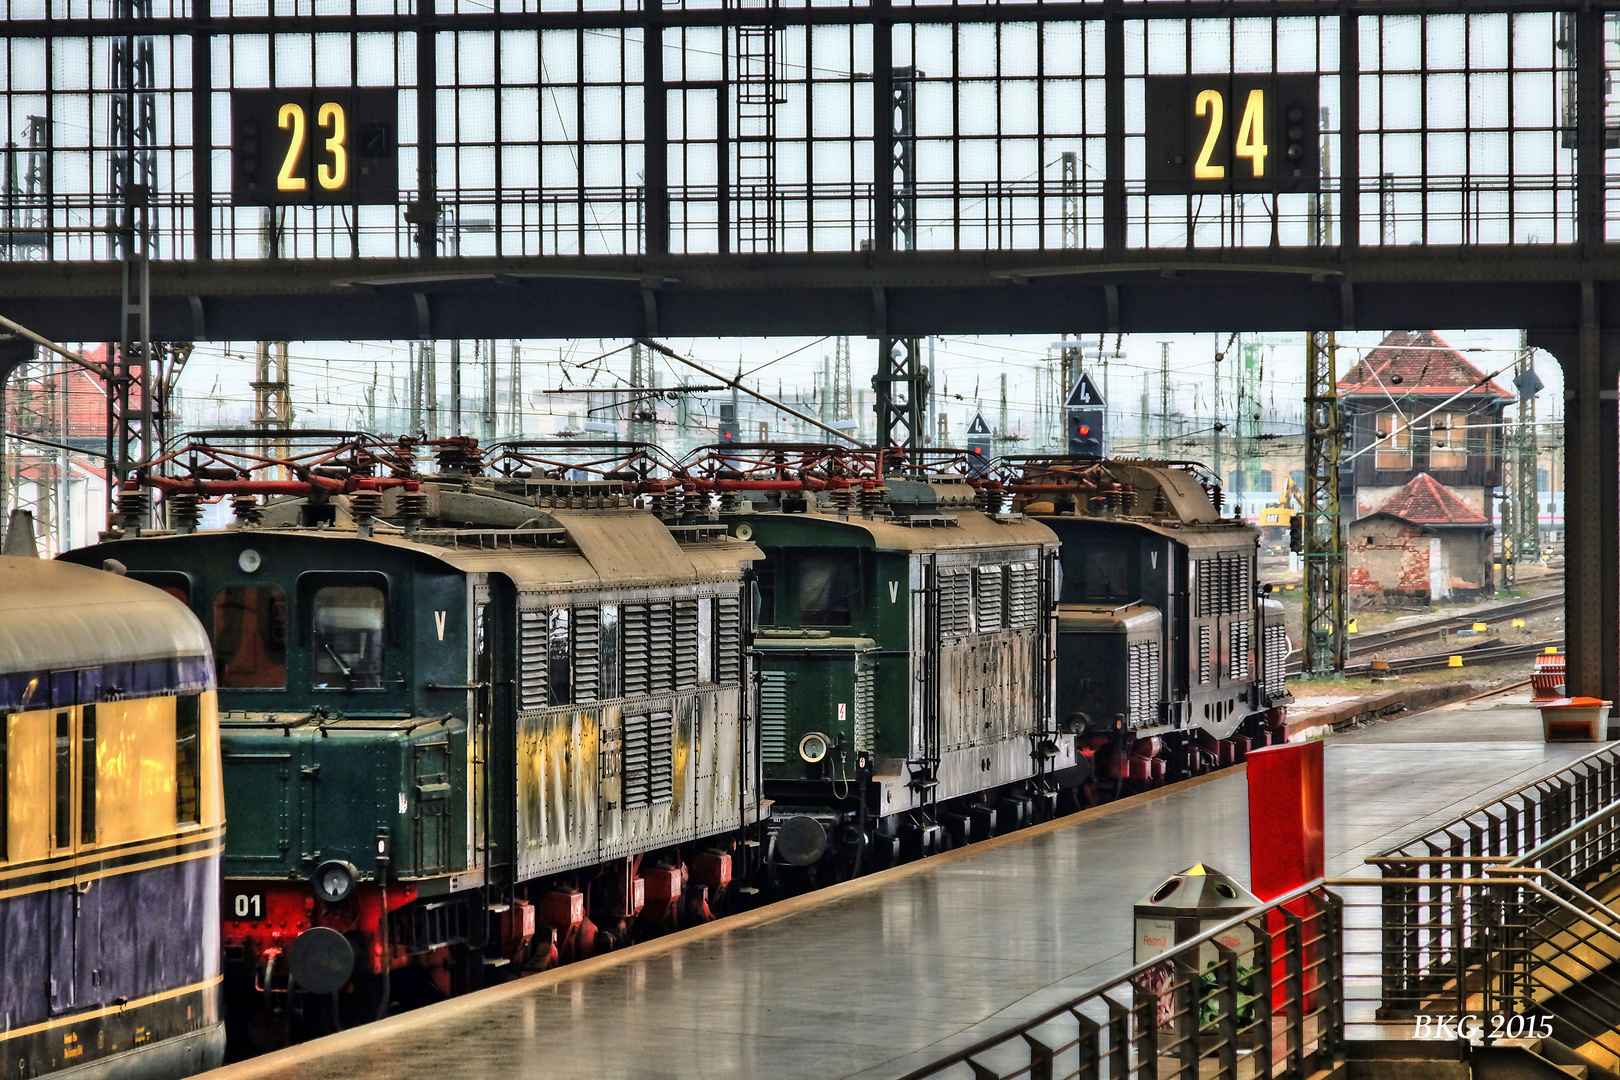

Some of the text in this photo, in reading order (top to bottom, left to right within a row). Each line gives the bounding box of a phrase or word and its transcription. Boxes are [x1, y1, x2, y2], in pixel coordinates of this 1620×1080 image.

[1194, 89, 1268, 179] 24
[277, 102, 348, 190] 23
[1080, 381, 1091, 404] 4
[975, 418, 983, 433] 4
[1266, 514, 1278, 522] CAT
[1150, 551, 1158, 570] V
[888, 580, 899, 604] V
[434, 610, 446, 641] V
[235, 894, 261, 917] 01
[1221, 935, 1241, 947] Glas
